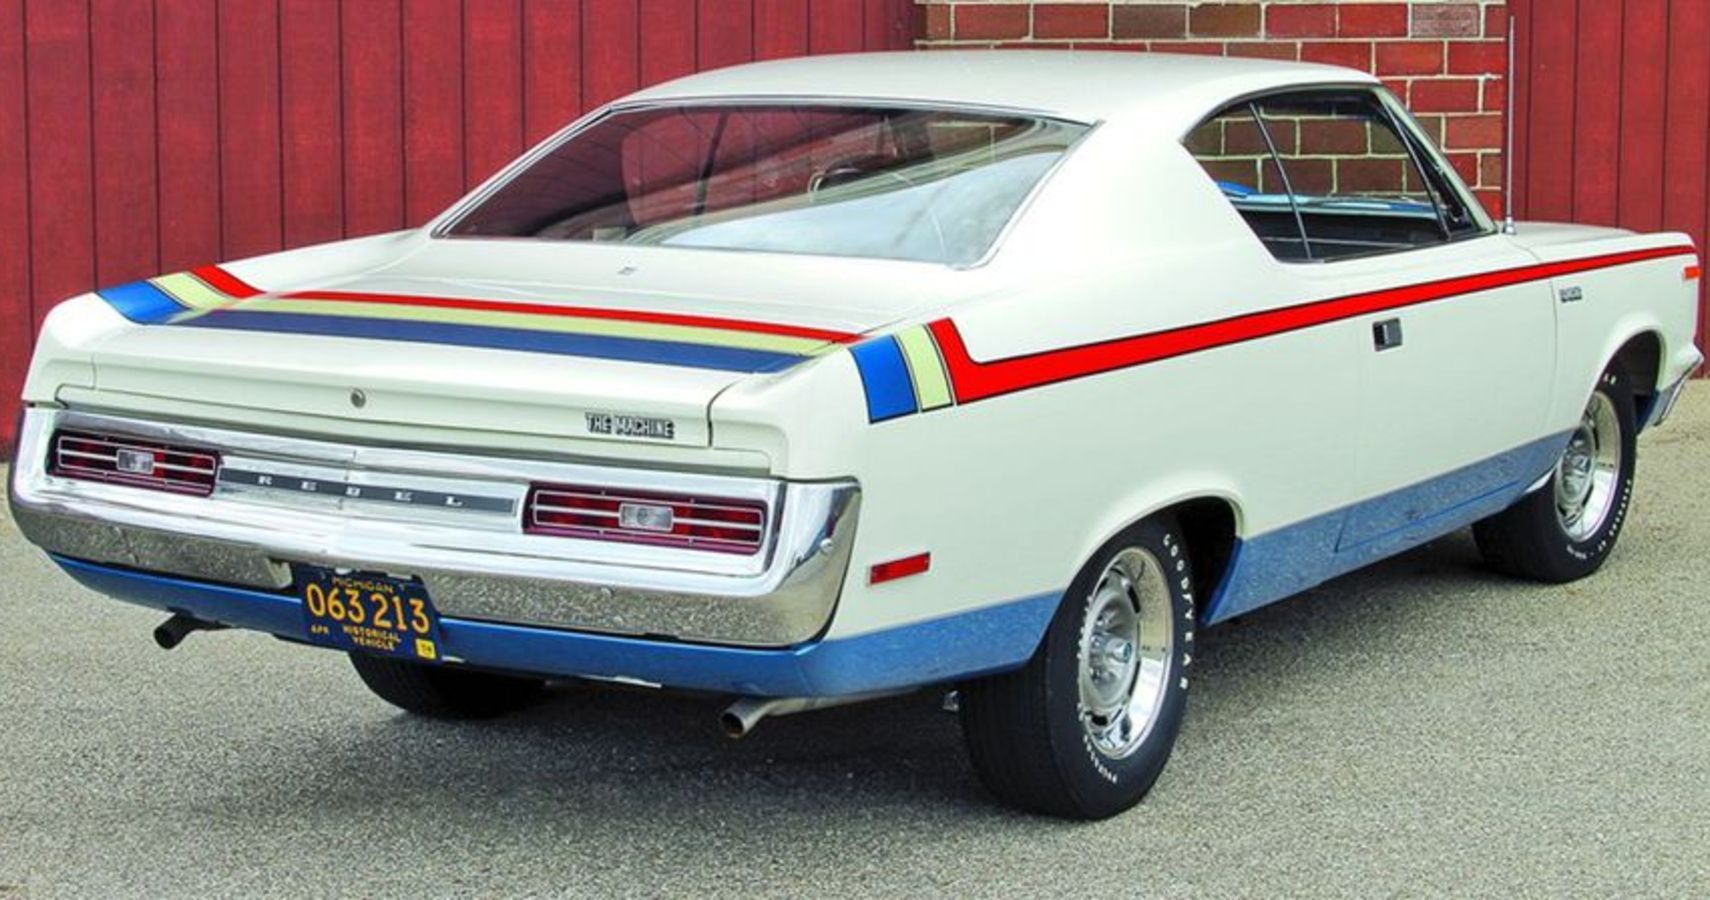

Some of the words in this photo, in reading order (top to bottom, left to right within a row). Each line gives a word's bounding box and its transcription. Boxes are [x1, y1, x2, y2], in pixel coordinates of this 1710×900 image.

[585, 412, 612, 434] THE
[614, 415, 675, 440] MACHINE
[257, 475, 463, 507] REBEL
[306, 583, 365, 624] 063
[370, 593, 430, 634] 213
